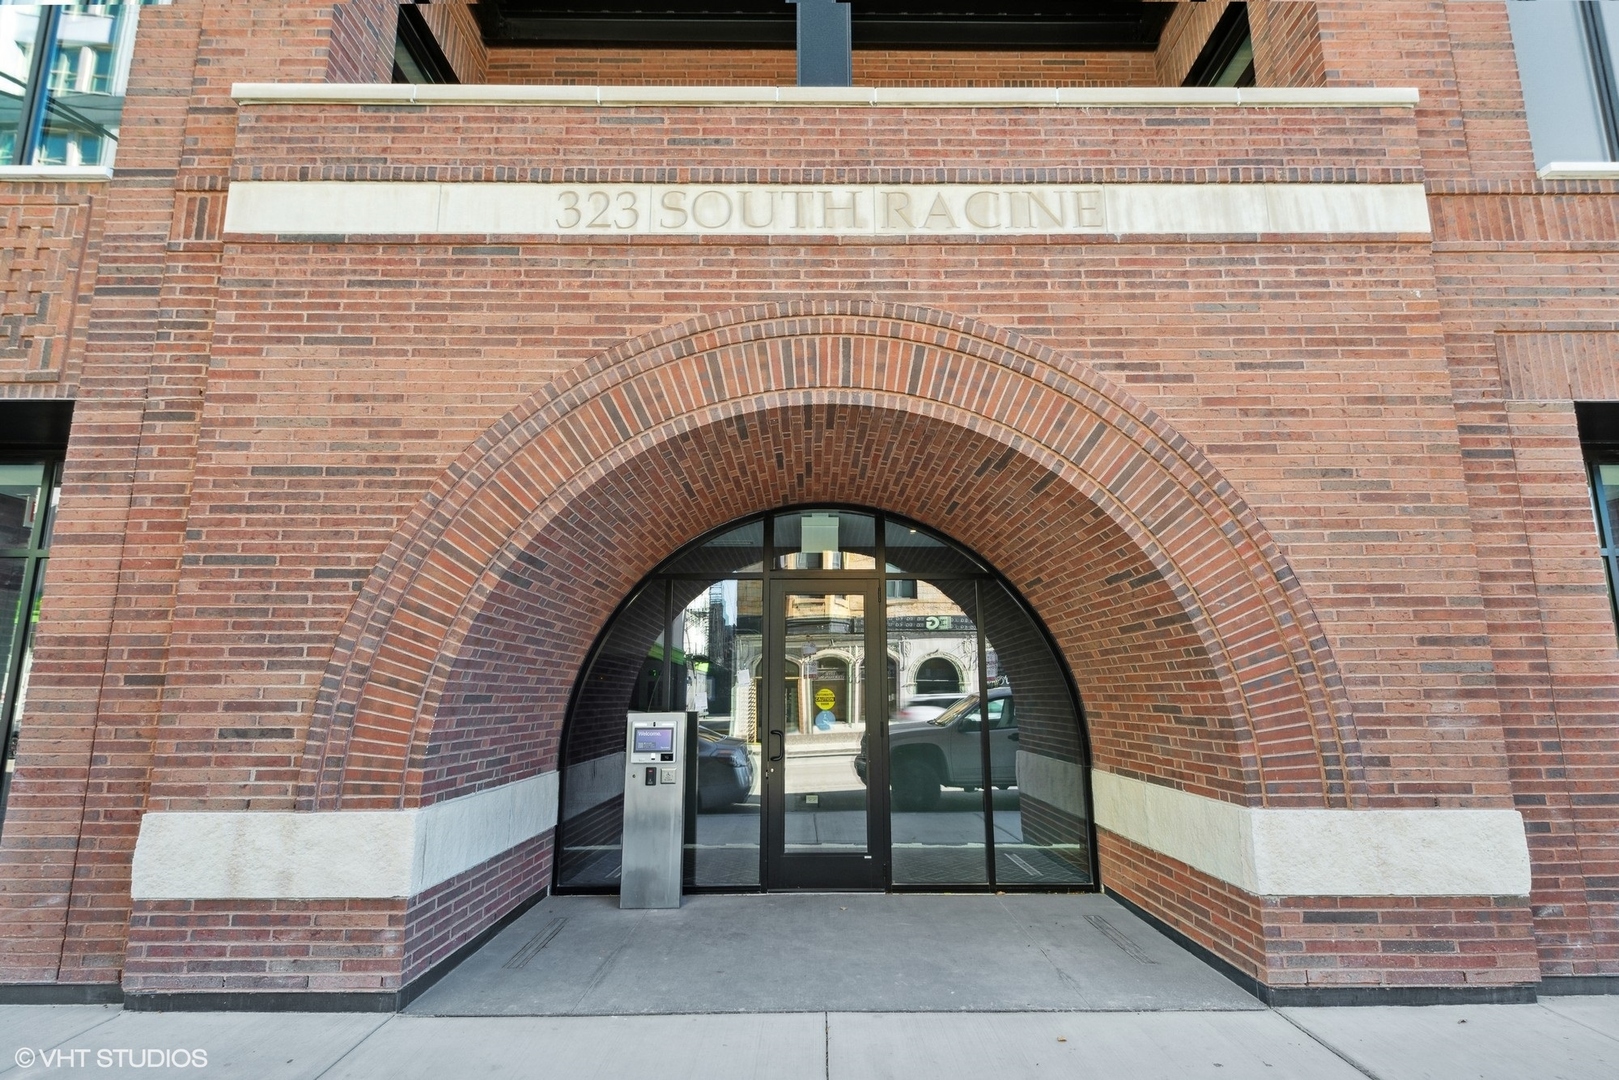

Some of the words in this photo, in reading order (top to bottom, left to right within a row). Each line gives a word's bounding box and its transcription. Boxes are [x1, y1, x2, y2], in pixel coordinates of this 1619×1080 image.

[555, 189, 640, 230] 323
[659, 189, 864, 230] SOUTH
[879, 189, 1105, 230] RACINE
